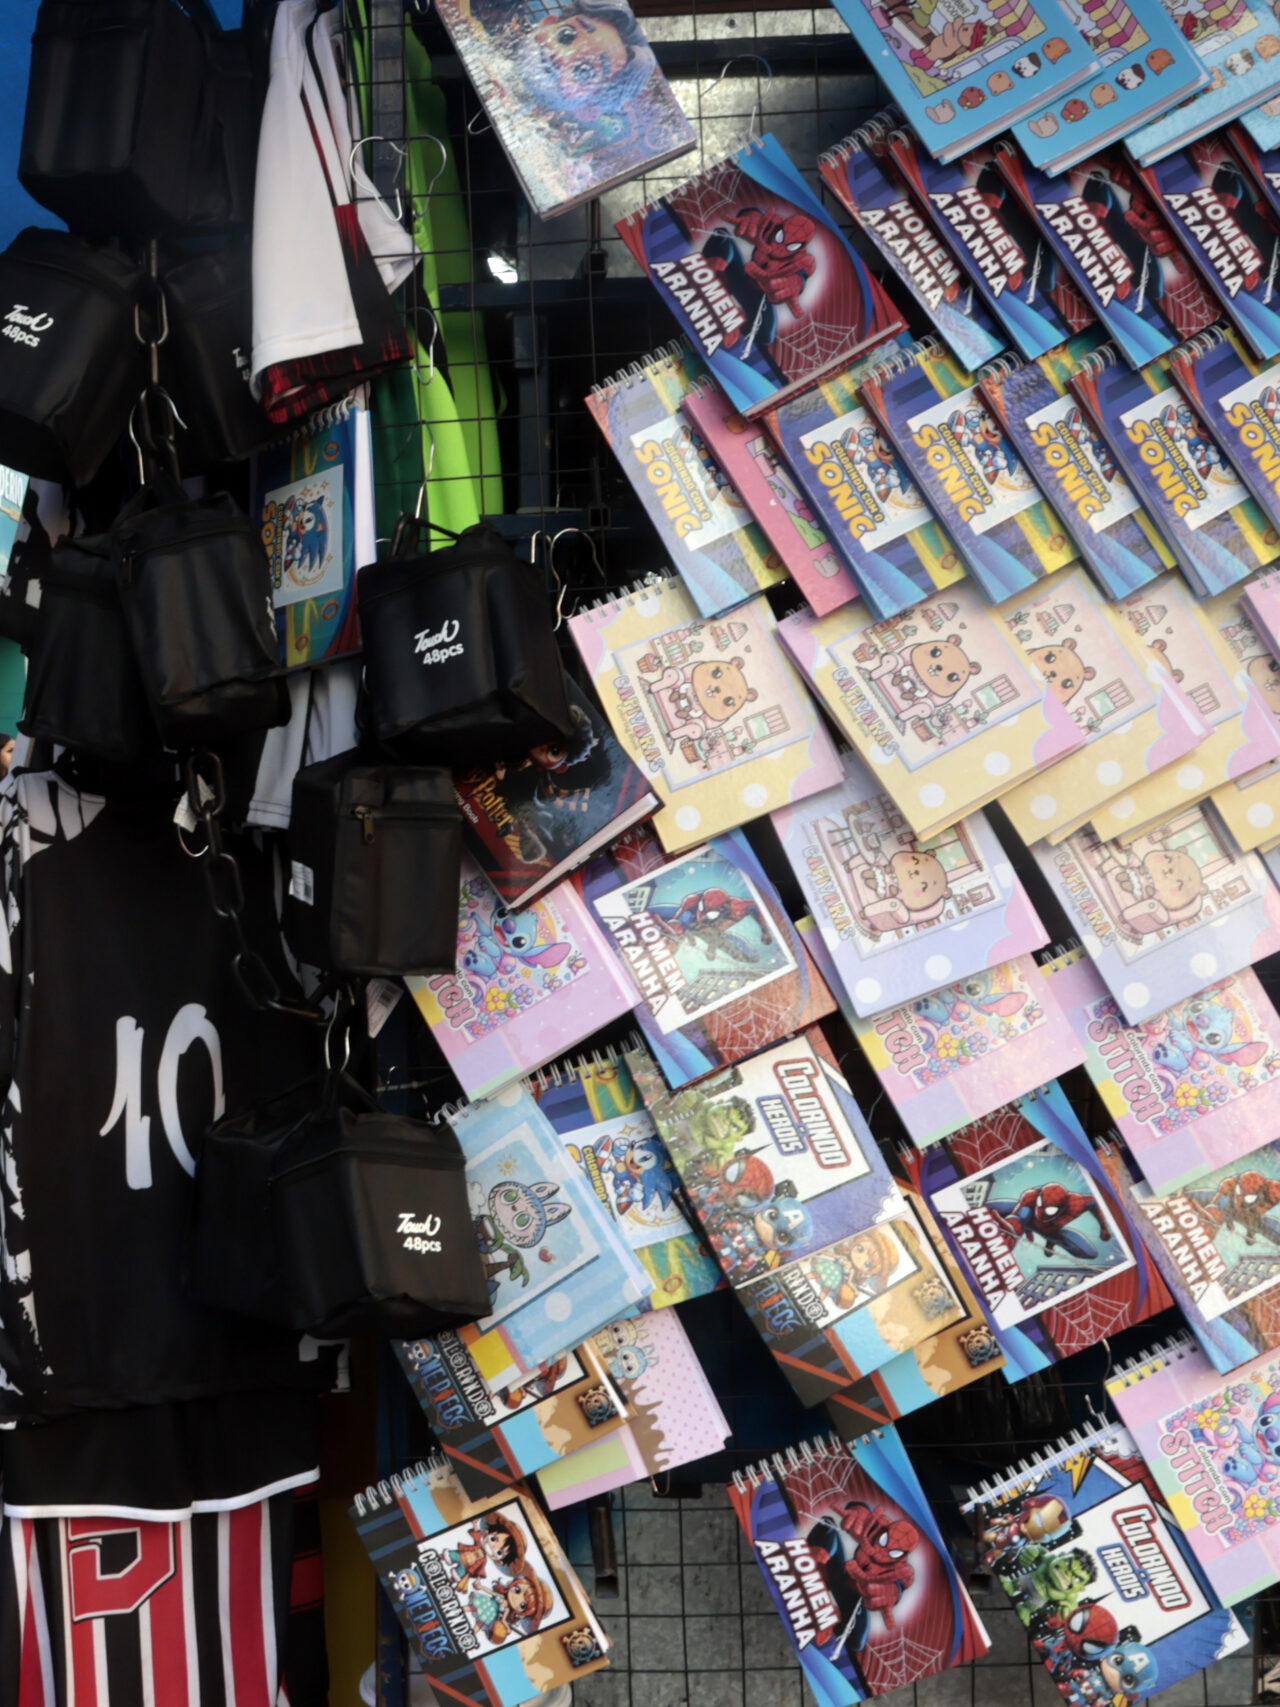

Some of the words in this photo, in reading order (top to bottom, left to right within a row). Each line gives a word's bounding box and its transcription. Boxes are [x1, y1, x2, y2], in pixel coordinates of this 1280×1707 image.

[859, 209, 945, 312] ARANHA
[888, 200, 960, 287] HOMEM
[928, 193, 1008, 299] ARANHA
[956, 186, 1026, 275] HOMEM
[1035, 202, 1116, 308] ARANHA
[1063, 195, 1133, 284] HOMEM
[1162, 193, 1245, 298] ARANHA
[1191, 186, 1263, 276] HOMEM
[1, 324, 41, 347] 48pcs
[649, 260, 724, 357] ARANHA
[680, 251, 746, 334] HOMEM
[634, 439, 703, 539] SONIC
[662, 438, 696, 490] COLORINDO
[689, 488, 710, 513] COM
[804, 441, 876, 540] SONIC
[830, 440, 867, 492] COLORINDO
[861, 490, 882, 514] COM
[912, 424, 986, 523] SONIC
[938, 422, 975, 475] COLORINDO
[968, 473, 989, 497] COM
[1030, 422, 1105, 521] SONIC
[1055, 421, 1092, 473] COLORINDO
[1087, 471, 1107, 496] COM
[1125, 420, 1200, 517] SONIC
[1151, 418, 1187, 471] COLORINDO
[1183, 468, 1202, 492] COM
[423, 643, 464, 665] 48pcs
[613, 674, 665, 773] CAPIVARAS
[832, 666, 900, 756] CAPIVARAS
[471, 774, 514, 832] Potter
[801, 844, 856, 941] CAPIVARAS
[1053, 852, 1117, 948] CAPIVARAS
[604, 916, 668, 1016] ARANHA
[629, 911, 687, 994] HOMEM
[424, 973, 476, 1029] TCH
[99, 1003, 225, 1190] 10
[775, 1059, 848, 1168] COLORINDO
[1087, 1016, 1164, 1123] STITCH
[760, 1098, 805, 1154] HEROIS
[403, 1236, 442, 1254] 48pcs
[940, 1211, 1005, 1312] ARANHA
[969, 1206, 1026, 1293] HOMEM
[1140, 1203, 1207, 1302] ARANHA
[1168, 1196, 1228, 1280] HOMEM
[782, 1265, 828, 1324] RINDO
[428, 1378, 472, 1428] PIECE
[1160, 1431, 1233, 1534] STITCH
[1198, 1445, 1222, 1488] Colorindo
[1219, 1485, 1232, 1504] com
[419, 1549, 480, 1653] COLORINDO
[754, 1539, 817, 1650] ARANHA
[784, 1537, 839, 1631] HOMEM
[1100, 1546, 1147, 1600] HEROIS
[1113, 1505, 1190, 1610] COLORINDO
[413, 1610, 454, 1659] PIECE
